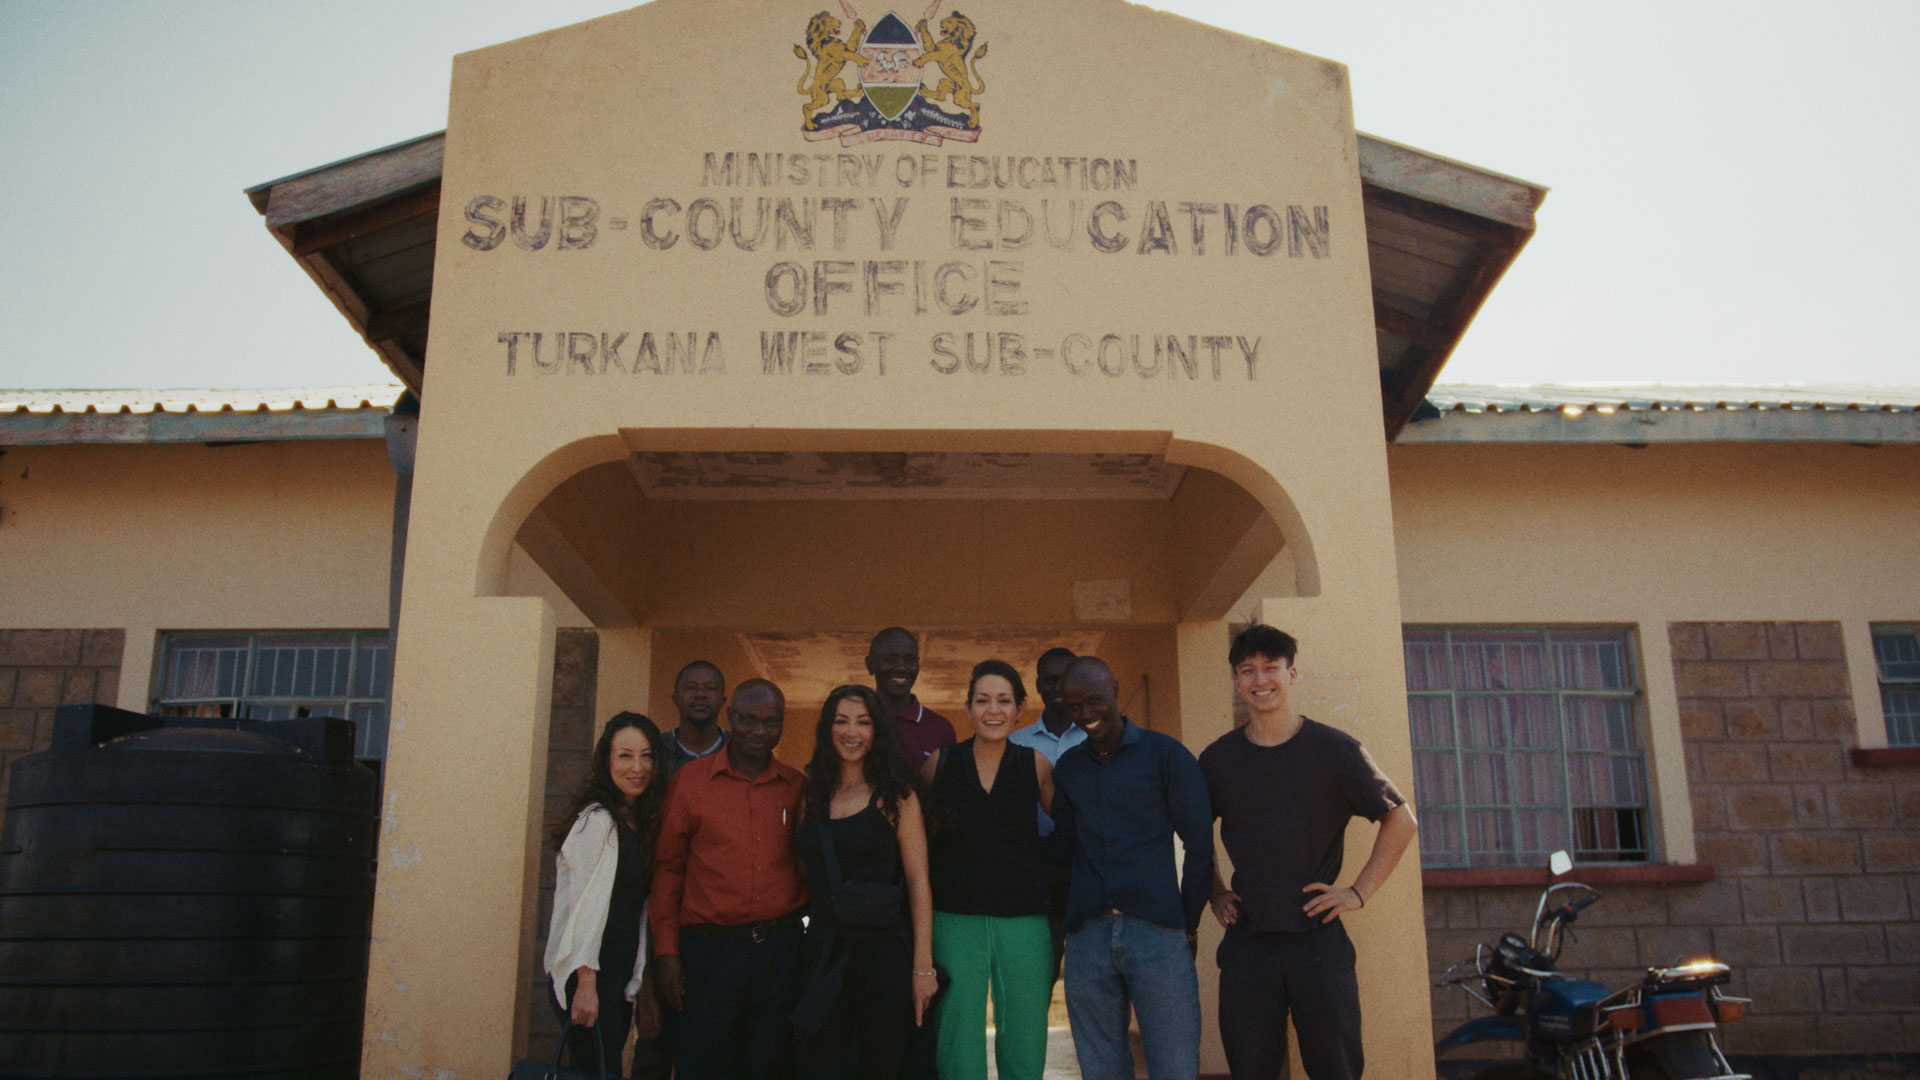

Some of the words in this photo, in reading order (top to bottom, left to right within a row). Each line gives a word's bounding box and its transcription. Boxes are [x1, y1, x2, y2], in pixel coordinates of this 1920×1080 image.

[847, 128, 934, 144] RAMBEE
[701, 151, 884, 188] MINISTRY
[896, 154, 939, 188] OF
[946, 154, 1138, 191] EDUCATION
[950, 196, 1331, 259] EDUCATION
[764, 259, 1028, 317] OFFICE
[498, 331, 728, 377] TURKANA
[759, 331, 896, 377] WEST
[930, 331, 1262, 381] SUB-COUNTY
